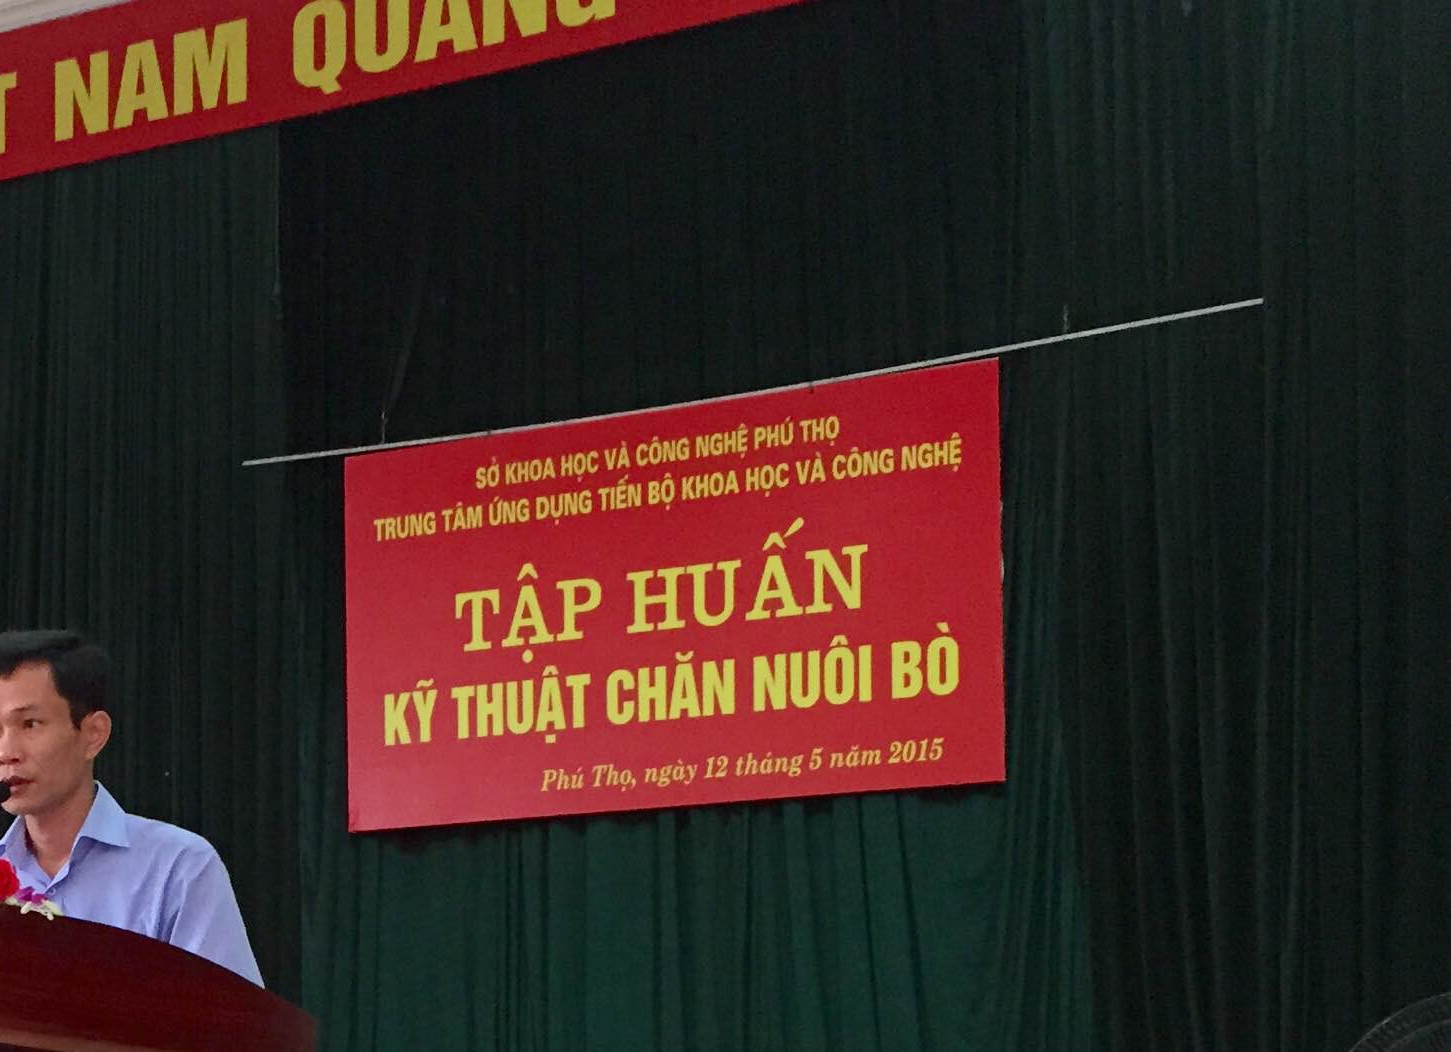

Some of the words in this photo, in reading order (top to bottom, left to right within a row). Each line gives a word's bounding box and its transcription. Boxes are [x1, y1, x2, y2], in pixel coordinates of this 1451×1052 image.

[55, 19, 247, 141] NAM
[373, 512, 436, 542] TRUNG
[441, 502, 483, 532] TÂM
[489, 496, 530, 526] ỨNG
[535, 490, 592, 525] DỤNG
[598, 474, 642, 512] TIẾN
[648, 472, 676, 510] BỘ
[681, 470, 740, 500] KHOA
[745, 463, 790, 497] HỌC
[795, 451, 826, 485] VÀ
[831, 446, 895, 480] CÔNG
[901, 432, 962, 472] NGHỆ
[475, 456, 500, 489] SỞ
[505, 457, 556, 484] KHOA
[561, 451, 599, 482] HỌC
[604, 441, 630, 470] VÀ
[636, 436, 690, 466] CÔNG
[696, 423, 748, 458] NGHỆ
[754, 417, 794, 450] PHÚ
[799, 415, 840, 446] THỌ
[454, 563, 602, 663] TẬP
[626, 517, 869, 634] HUẤN
[383, 678, 435, 746] KỸ
[450, 665, 592, 744] THUẬT
[606, 651, 735, 725] CHĂN
[753, 635, 872, 712] NUÔI
[890, 621, 960, 697] BÒ
[540, 767, 584, 791] Phú
[592, 764, 636, 791] Thọ,
[644, 758, 698, 785] ngày
[704, 756, 728, 778] 12
[735, 752, 804, 777] tháng
[809, 748, 823, 770] 5
[830, 745, 881, 768] năm
[888, 738, 944, 764] 2015
